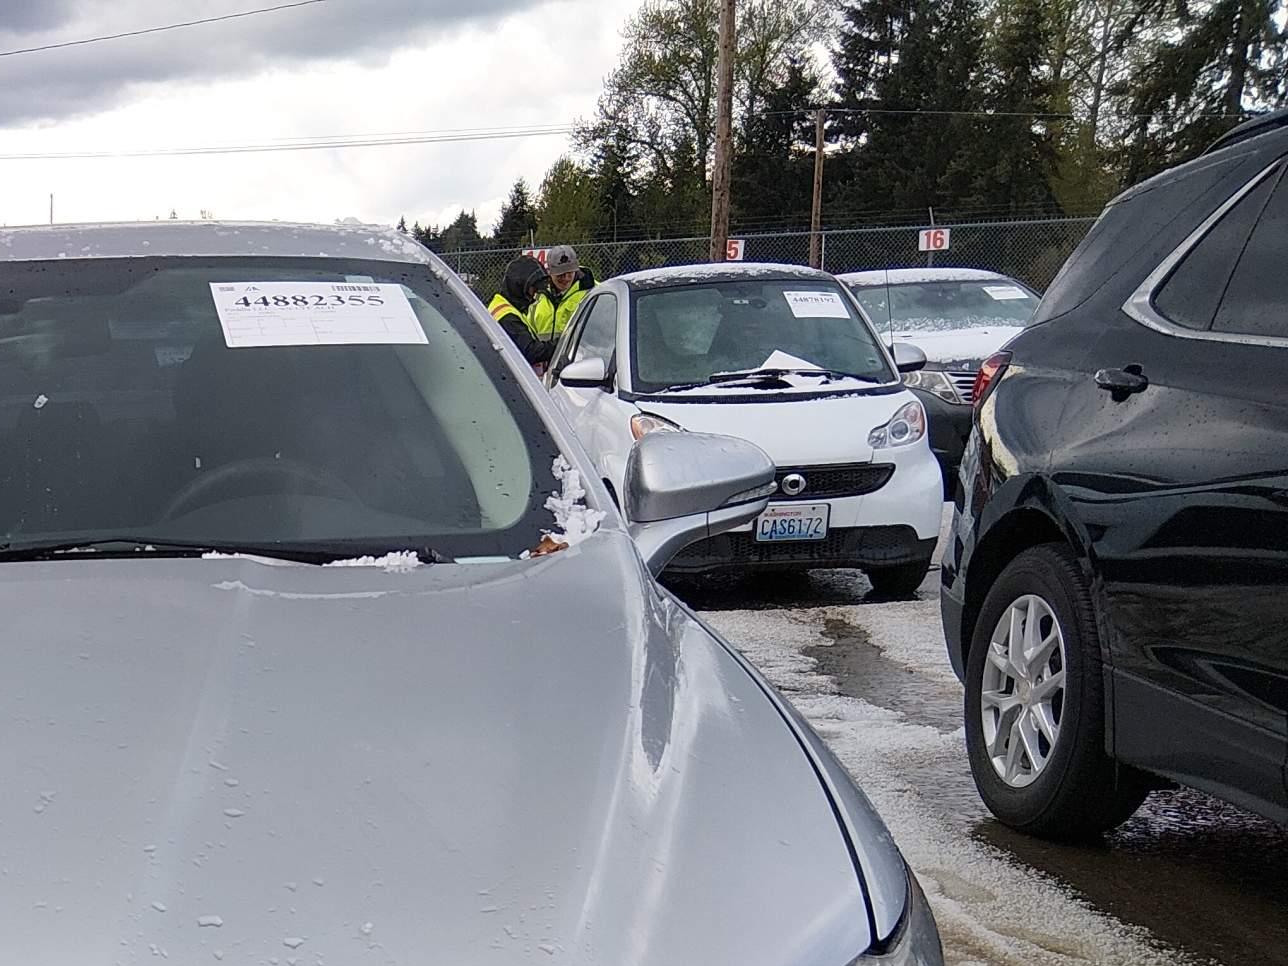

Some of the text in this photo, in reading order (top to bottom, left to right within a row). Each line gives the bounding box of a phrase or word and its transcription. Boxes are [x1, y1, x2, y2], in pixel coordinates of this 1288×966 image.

[924, 230, 945, 250] 16
[727, 240, 739, 260] 5
[233, 294, 386, 308] 44882355
[761, 517, 823, 536] CAS6172
